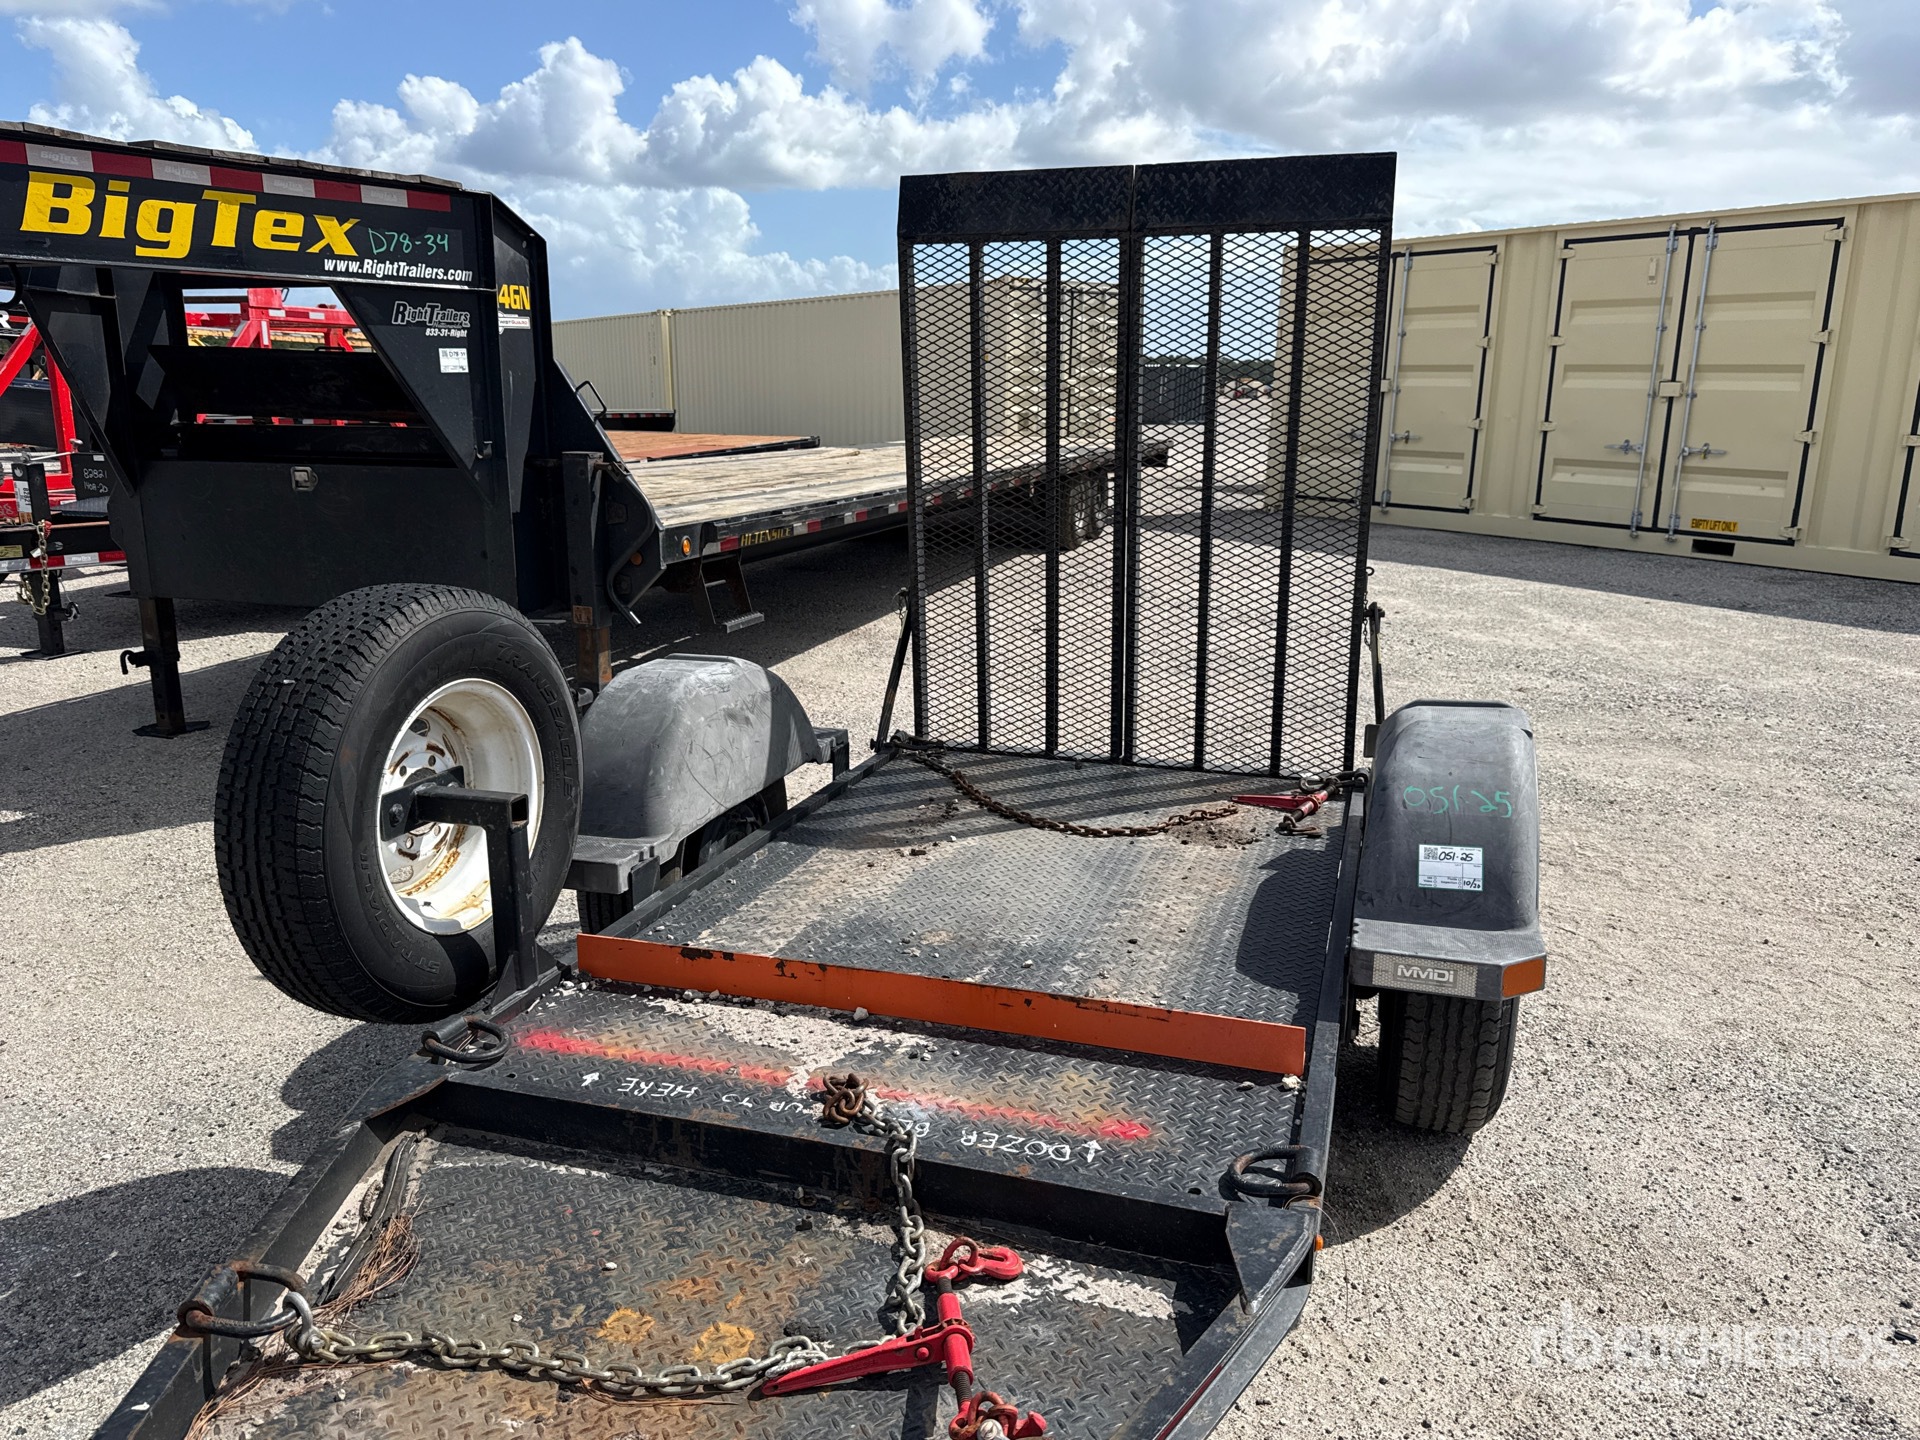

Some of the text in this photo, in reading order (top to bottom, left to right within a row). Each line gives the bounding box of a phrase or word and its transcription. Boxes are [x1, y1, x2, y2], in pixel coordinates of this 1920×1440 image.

[19, 171, 361, 258] BigTex
[368, 228, 449, 256] D78-34
[324, 258, 473, 282] www.RightTrailers.com
[425, 328, 468, 338] 833-31-Right
[83, 467, 108, 479] 82821
[1691, 518, 1738, 532] EMPTY LIFT ONLY
[740, 527, 792, 547] HI-TENSILE
[616, 1076, 699, 1099] HERE
[769, 1099, 805, 1114] UP
[960, 1128, 1072, 1162] DOZER
